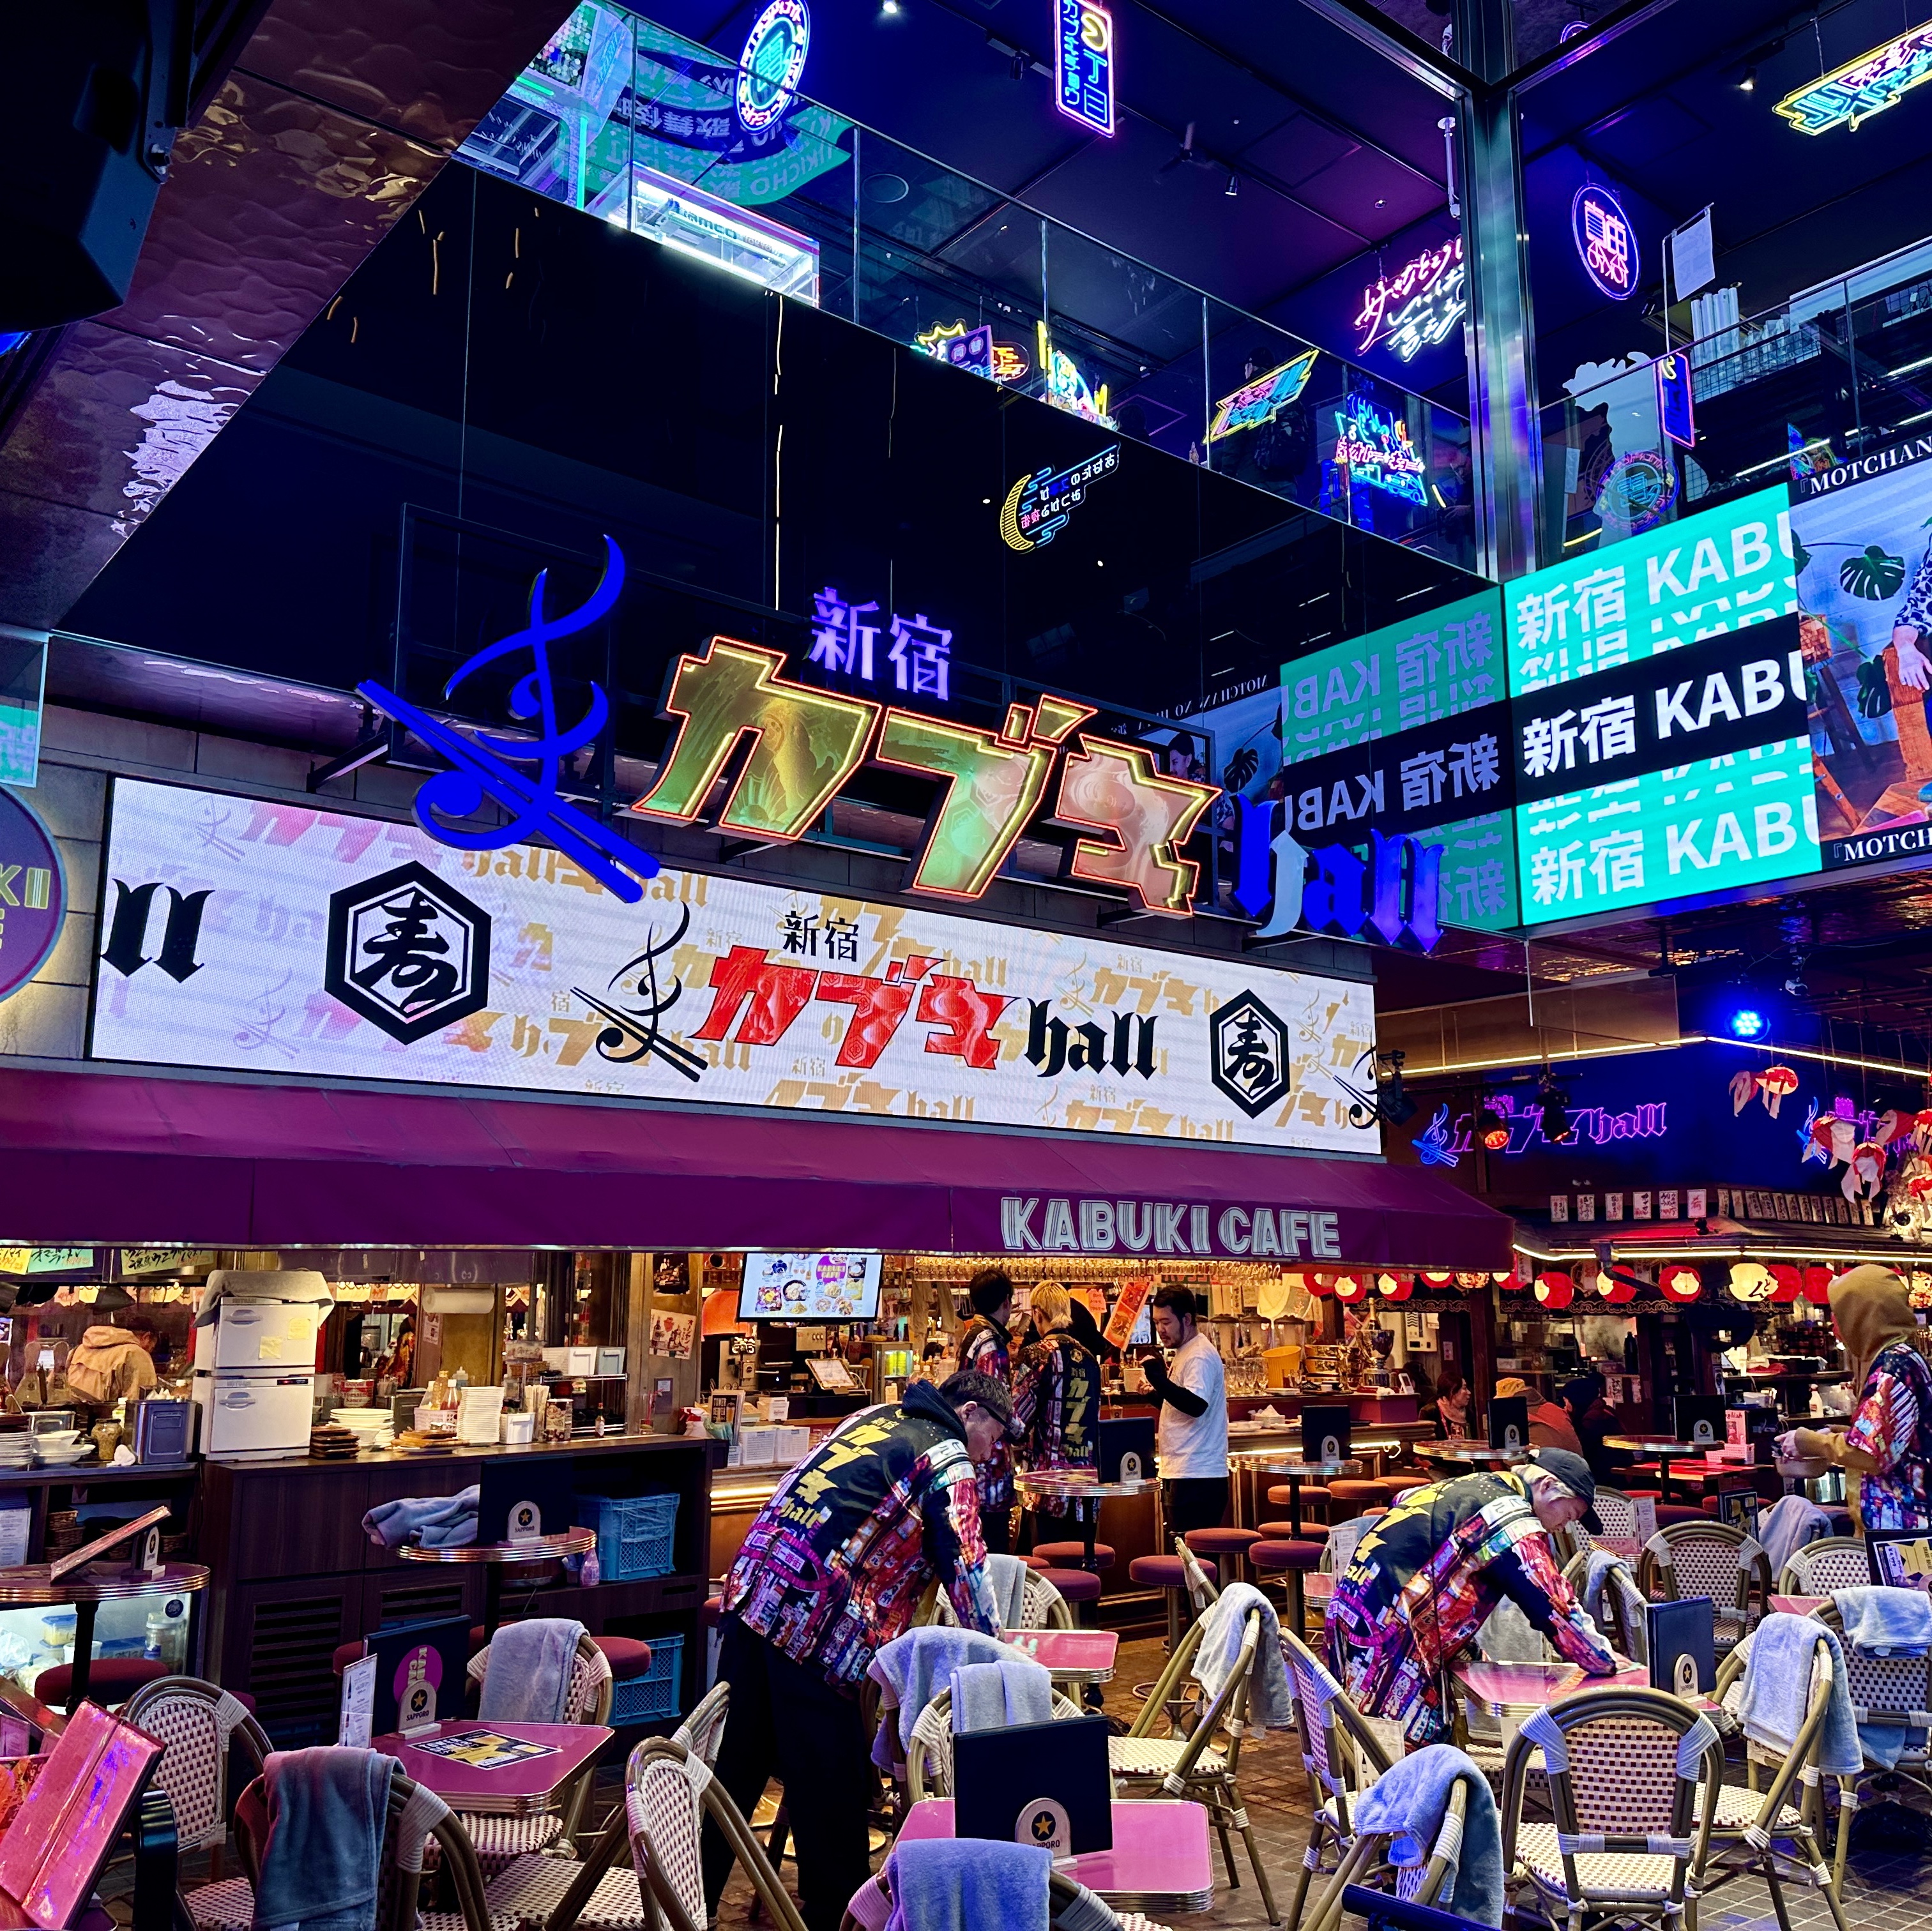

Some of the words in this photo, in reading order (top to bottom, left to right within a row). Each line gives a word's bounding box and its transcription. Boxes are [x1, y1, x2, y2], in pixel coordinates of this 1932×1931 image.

[809, 586, 952, 700] 新宿
[1517, 564, 1627, 651] 新宿
[1523, 694, 1636, 778] 新宿
[631, 635, 1222, 916] カブキ
[1229, 793, 1445, 953] hall
[1531, 829, 1646, 905] 新宿
[783, 911, 859, 962] 新宿
[688, 944, 1023, 1071] カブキ
[1024, 997, 1159, 1080] hall
[1089, 966, 1199, 1016] カブキ
[1590, 1102, 1667, 1144] hall
[1000, 1196, 1211, 1255] KABUKI
[1218, 1206, 1342, 1259] CAFE
[1065, 1377, 1092, 1446] カブキ
[795, 1423, 892, 1506] カブキ
[779, 1495, 826, 1530] hall
[406, 1709, 430, 1722] SAPPORO
